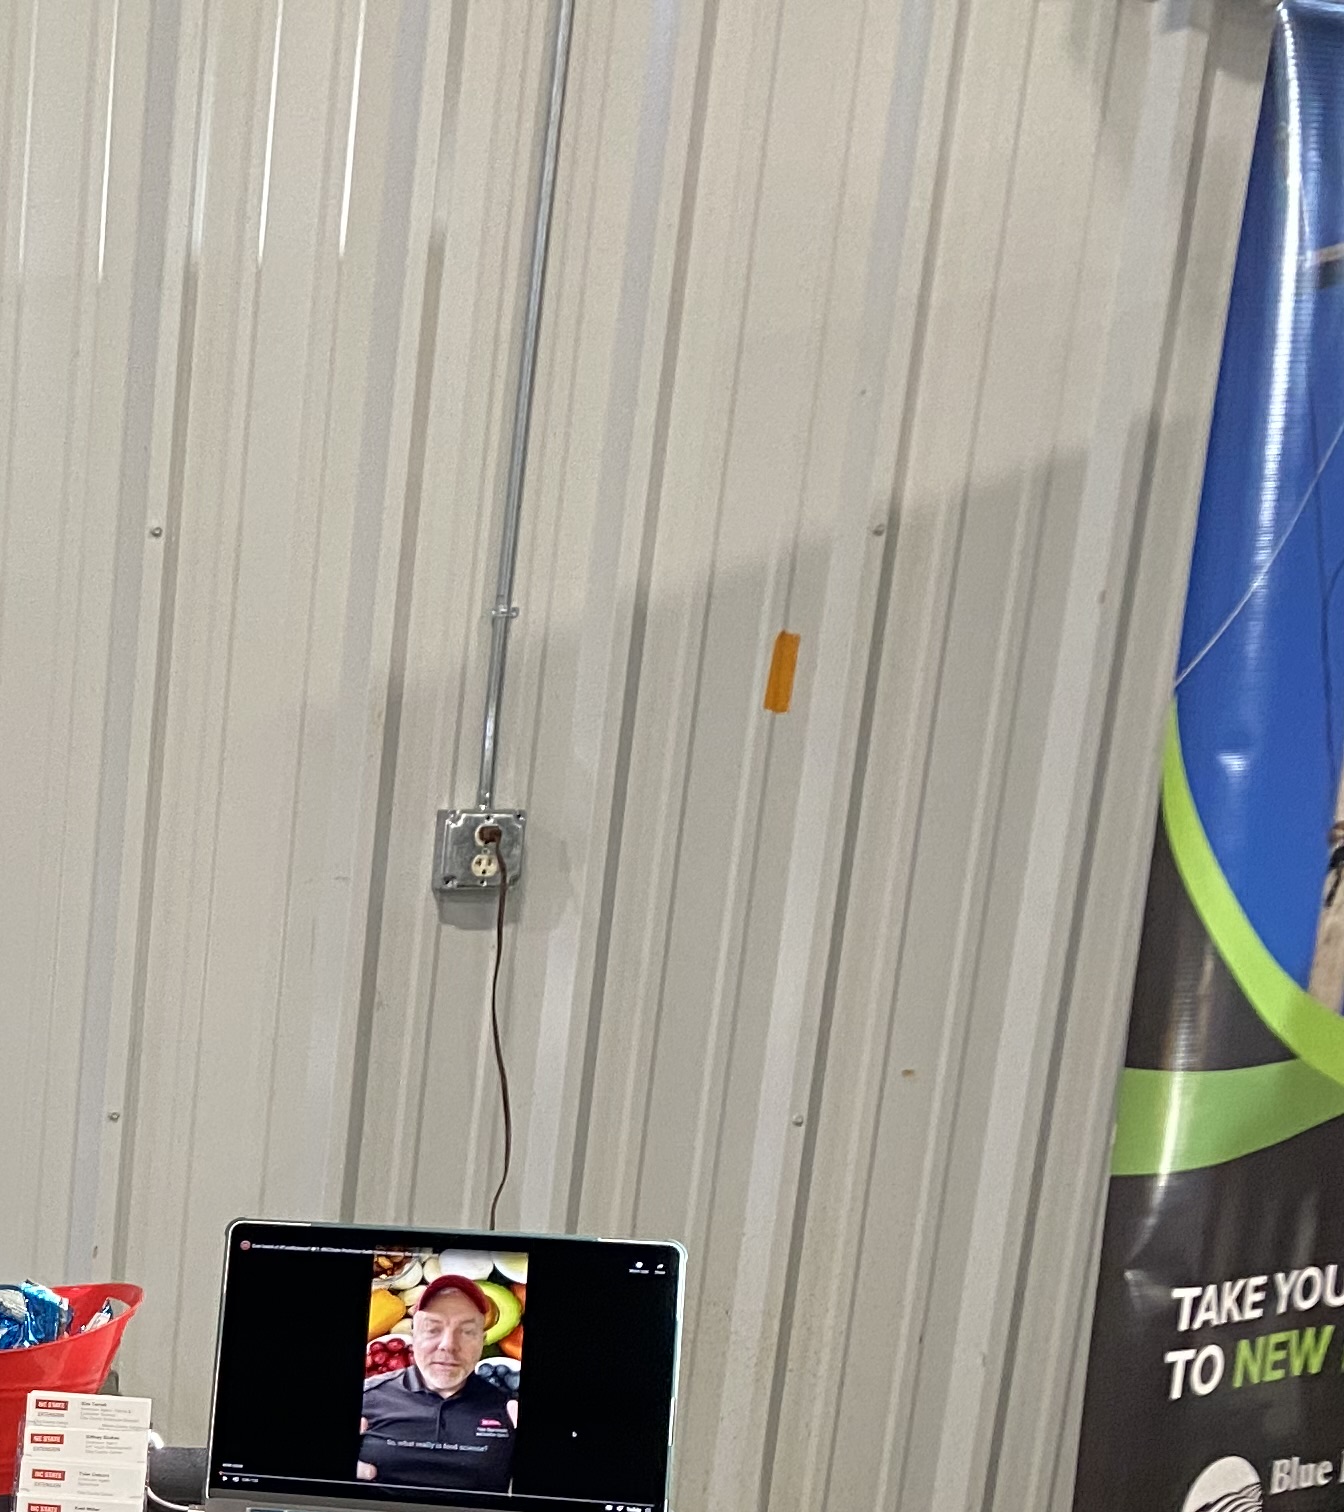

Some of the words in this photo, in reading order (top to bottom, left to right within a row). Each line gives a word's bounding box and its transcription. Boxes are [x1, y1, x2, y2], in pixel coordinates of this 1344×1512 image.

[1170, 1275, 1269, 1332] TAKE
[1164, 1344, 1225, 1401] TO
[1231, 1324, 1336, 1388] NEW
[1269, 1455, 1333, 1496] Blue
